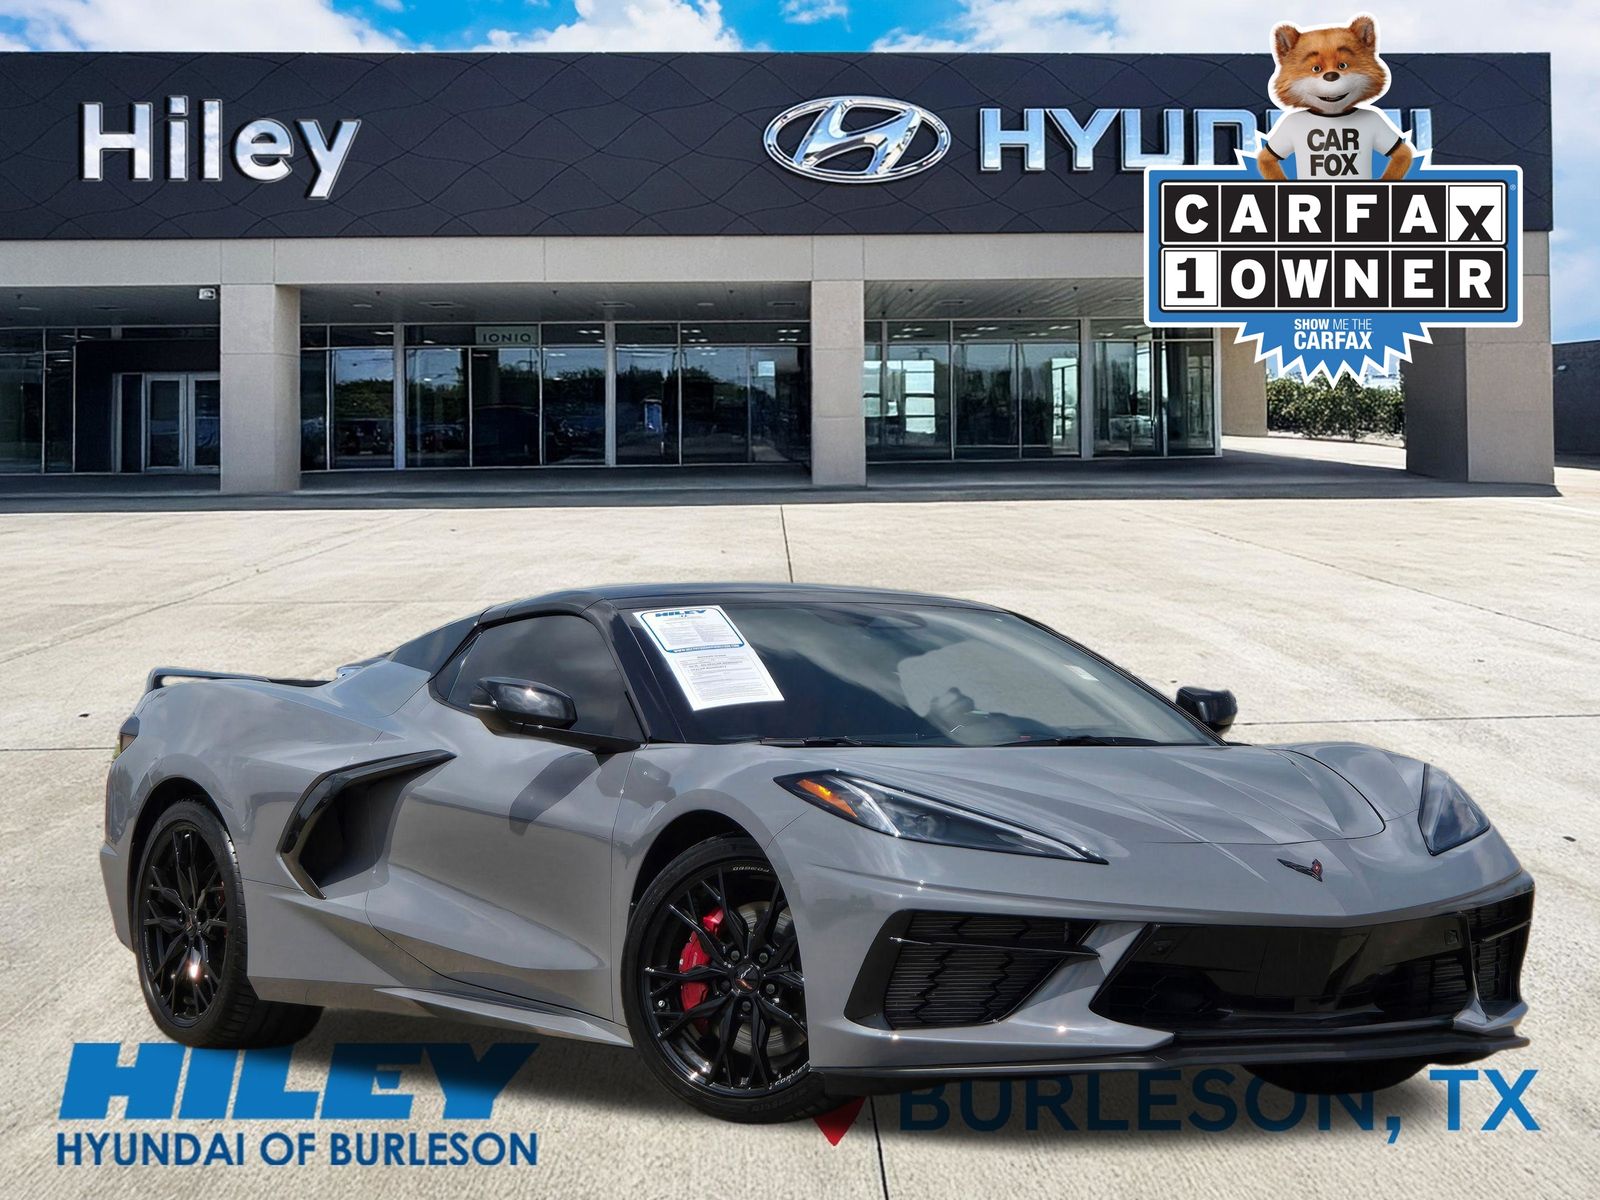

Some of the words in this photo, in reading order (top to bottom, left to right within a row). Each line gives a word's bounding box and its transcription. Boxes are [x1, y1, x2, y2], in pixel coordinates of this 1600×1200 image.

[79, 95, 362, 200] Hiley
[979, 107, 1432, 171] HYUNI
[483, 332, 532, 343] IONIQ
